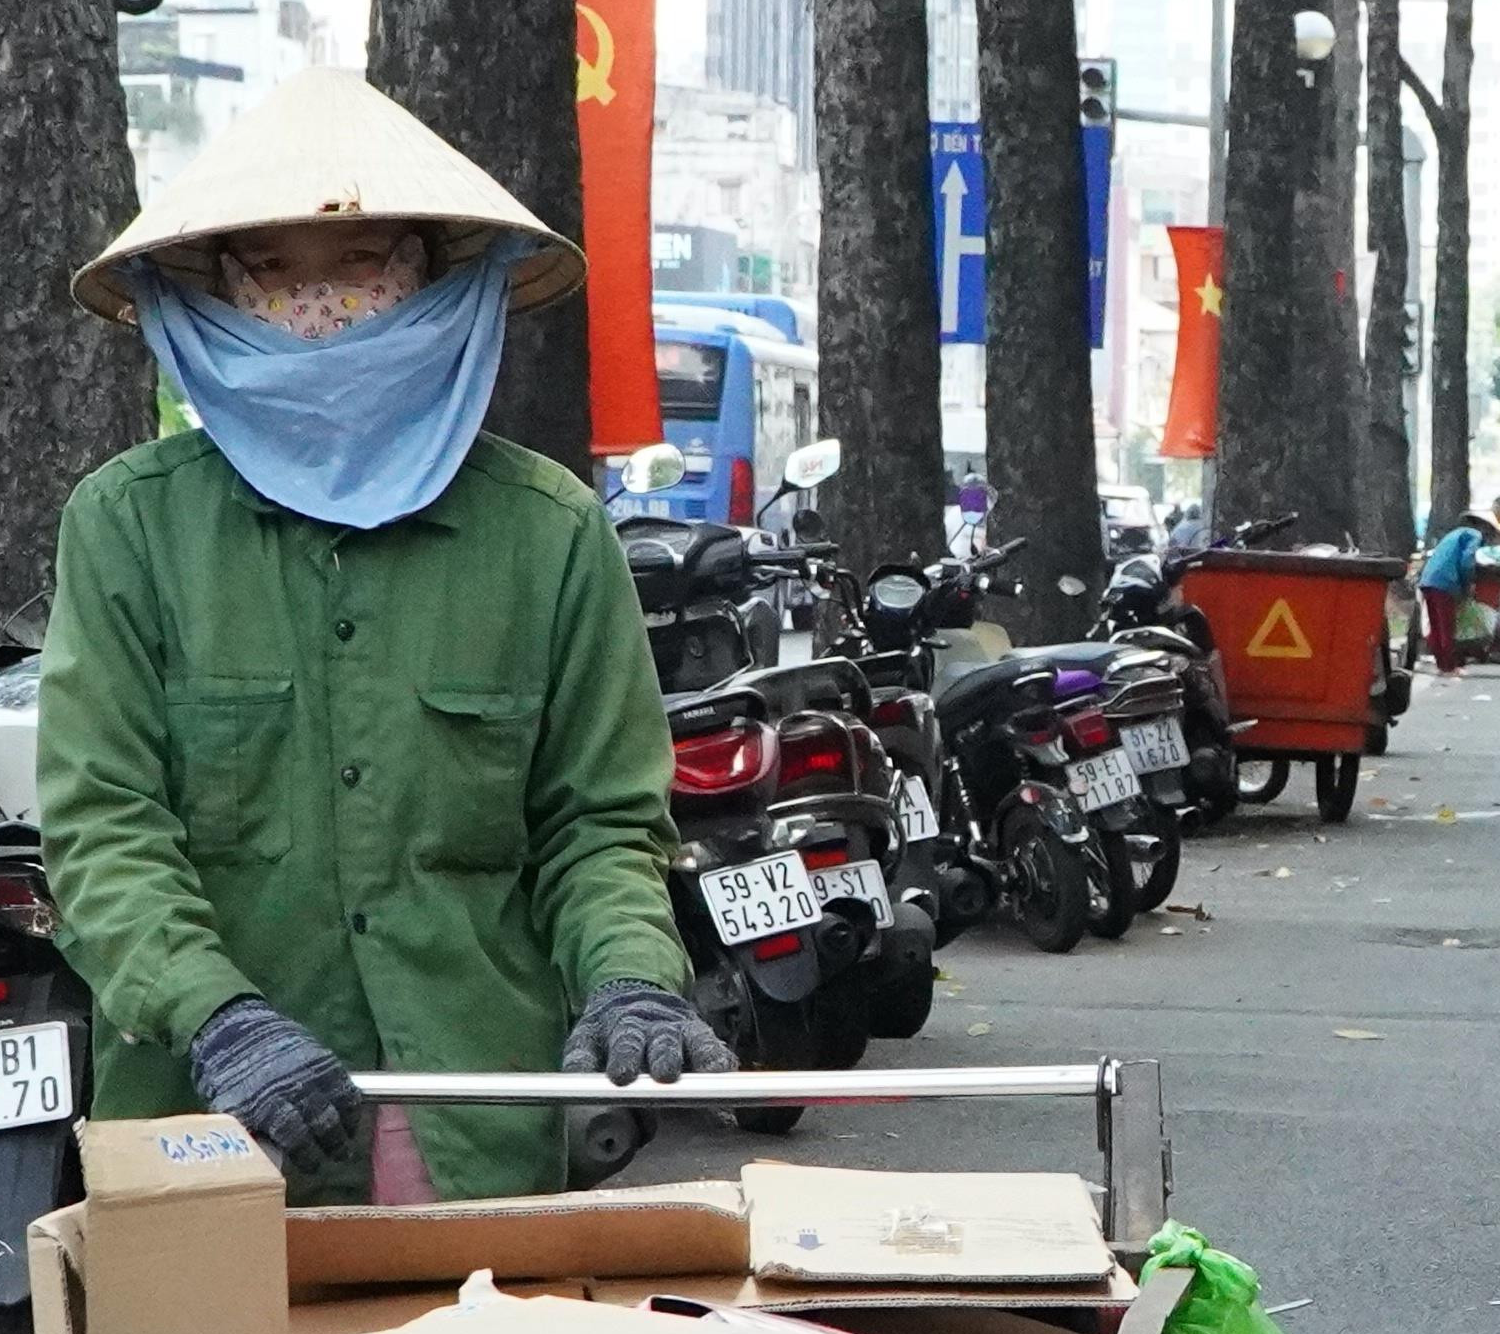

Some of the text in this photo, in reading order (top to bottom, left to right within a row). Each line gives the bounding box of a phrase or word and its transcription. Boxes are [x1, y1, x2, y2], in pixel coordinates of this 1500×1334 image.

[1076, 752, 1123, 783] 59-E1
[718, 861, 795, 904] 59-V2
[721, 891, 814, 938] 543.20
